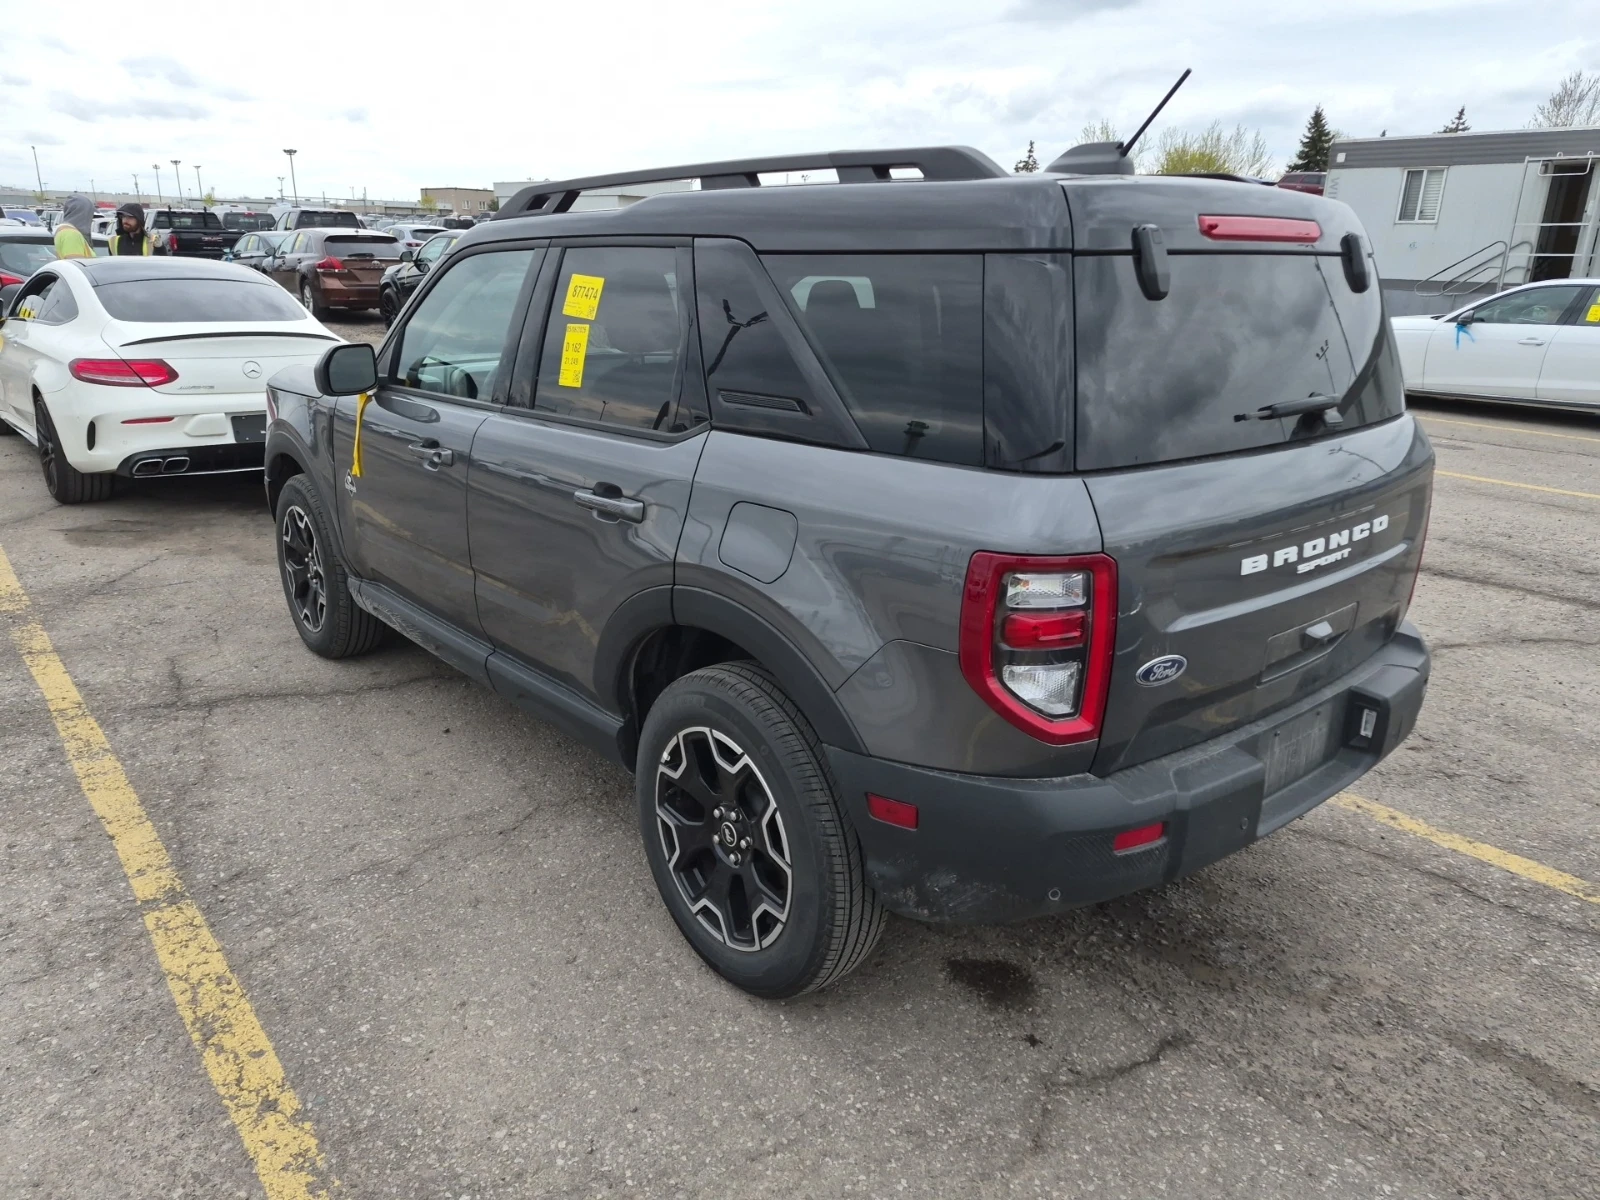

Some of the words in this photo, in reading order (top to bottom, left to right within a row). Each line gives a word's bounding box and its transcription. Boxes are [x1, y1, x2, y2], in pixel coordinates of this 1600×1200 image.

[572, 285, 599, 300] 877474
[571, 342, 581, 353] 162
[1241, 514, 1389, 576] BRONCO
[1296, 548, 1351, 574] SPORT
[1149, 661, 1178, 681] Ford
